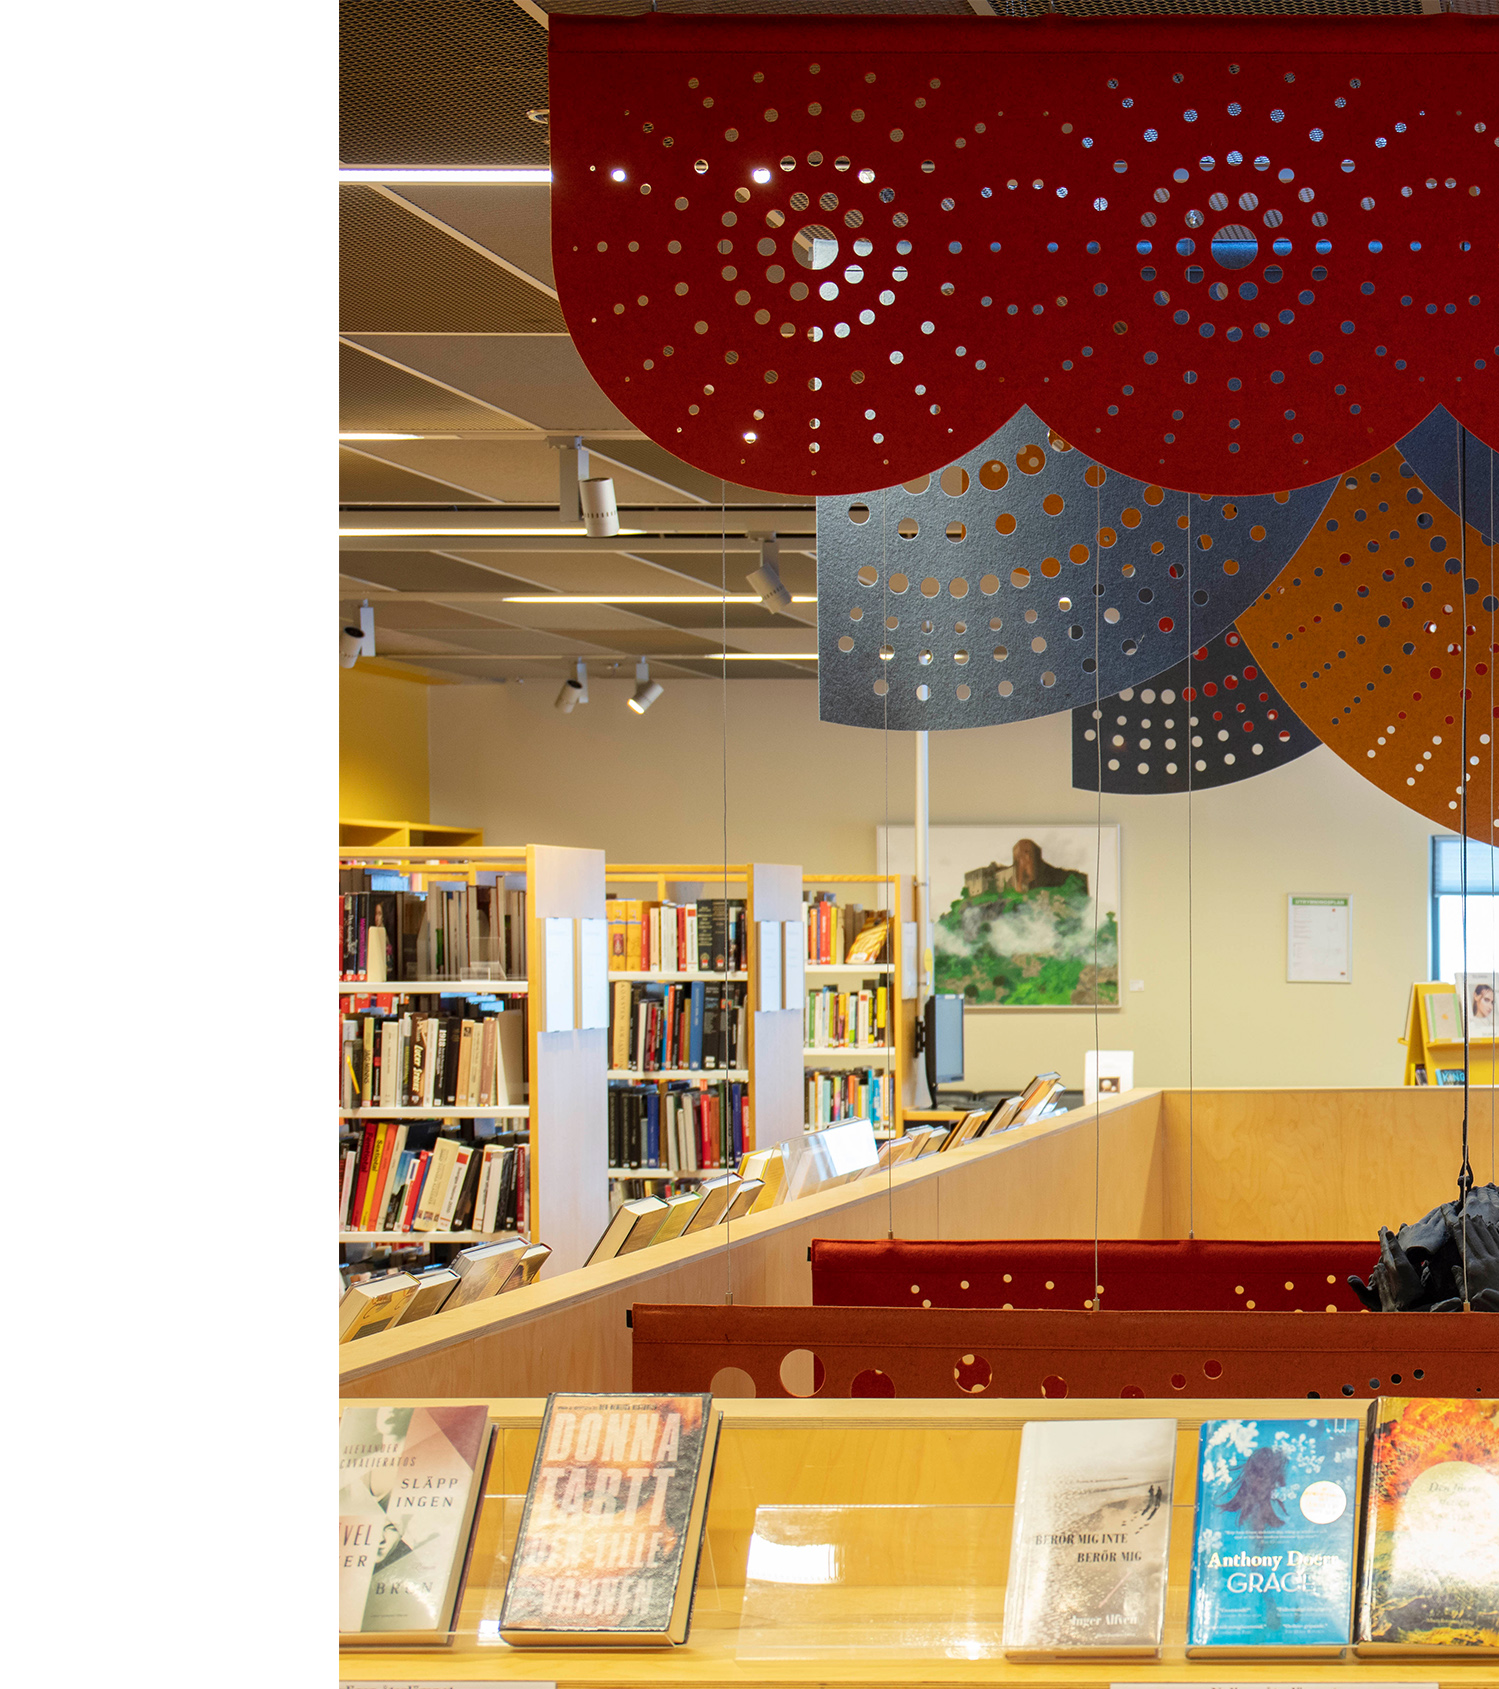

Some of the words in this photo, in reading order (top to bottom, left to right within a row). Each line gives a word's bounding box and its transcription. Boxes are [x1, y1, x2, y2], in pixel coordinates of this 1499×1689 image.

[413, 1044, 424, 1067] LUCKY
[412, 1067, 423, 1092] STRIKE
[362, 1131, 374, 1173] Femtiotal
[372, 1139, 384, 1173] Sextiotal
[546, 1413, 681, 1462] DONNA
[343, 1443, 399, 1455] ALEXANDER
[340, 1457, 417, 1469] CAVALIERATOS
[401, 1476, 459, 1490] SLÄPP
[396, 1496, 454, 1508] INGEN
[536, 1467, 677, 1526] TARTT
[339, 1523, 373, 1546] VEL
[1035, 1532, 1075, 1545] BERÖR
[1078, 1534, 1099, 1544] MIG
[1101, 1533, 1129, 1544] INTE
[593, 1532, 664, 1568] LILLE
[1077, 1550, 1117, 1563] BERÖR
[1121, 1551, 1142, 1561] MIG
[339, 1555, 368, 1568] ER
[1207, 1551, 1283, 1572] Anthony
[1286, 1550, 1340, 1566] Doerr
[375, 1581, 435, 1596] BRN
[1227, 1572, 1317, 1593] GRACE
